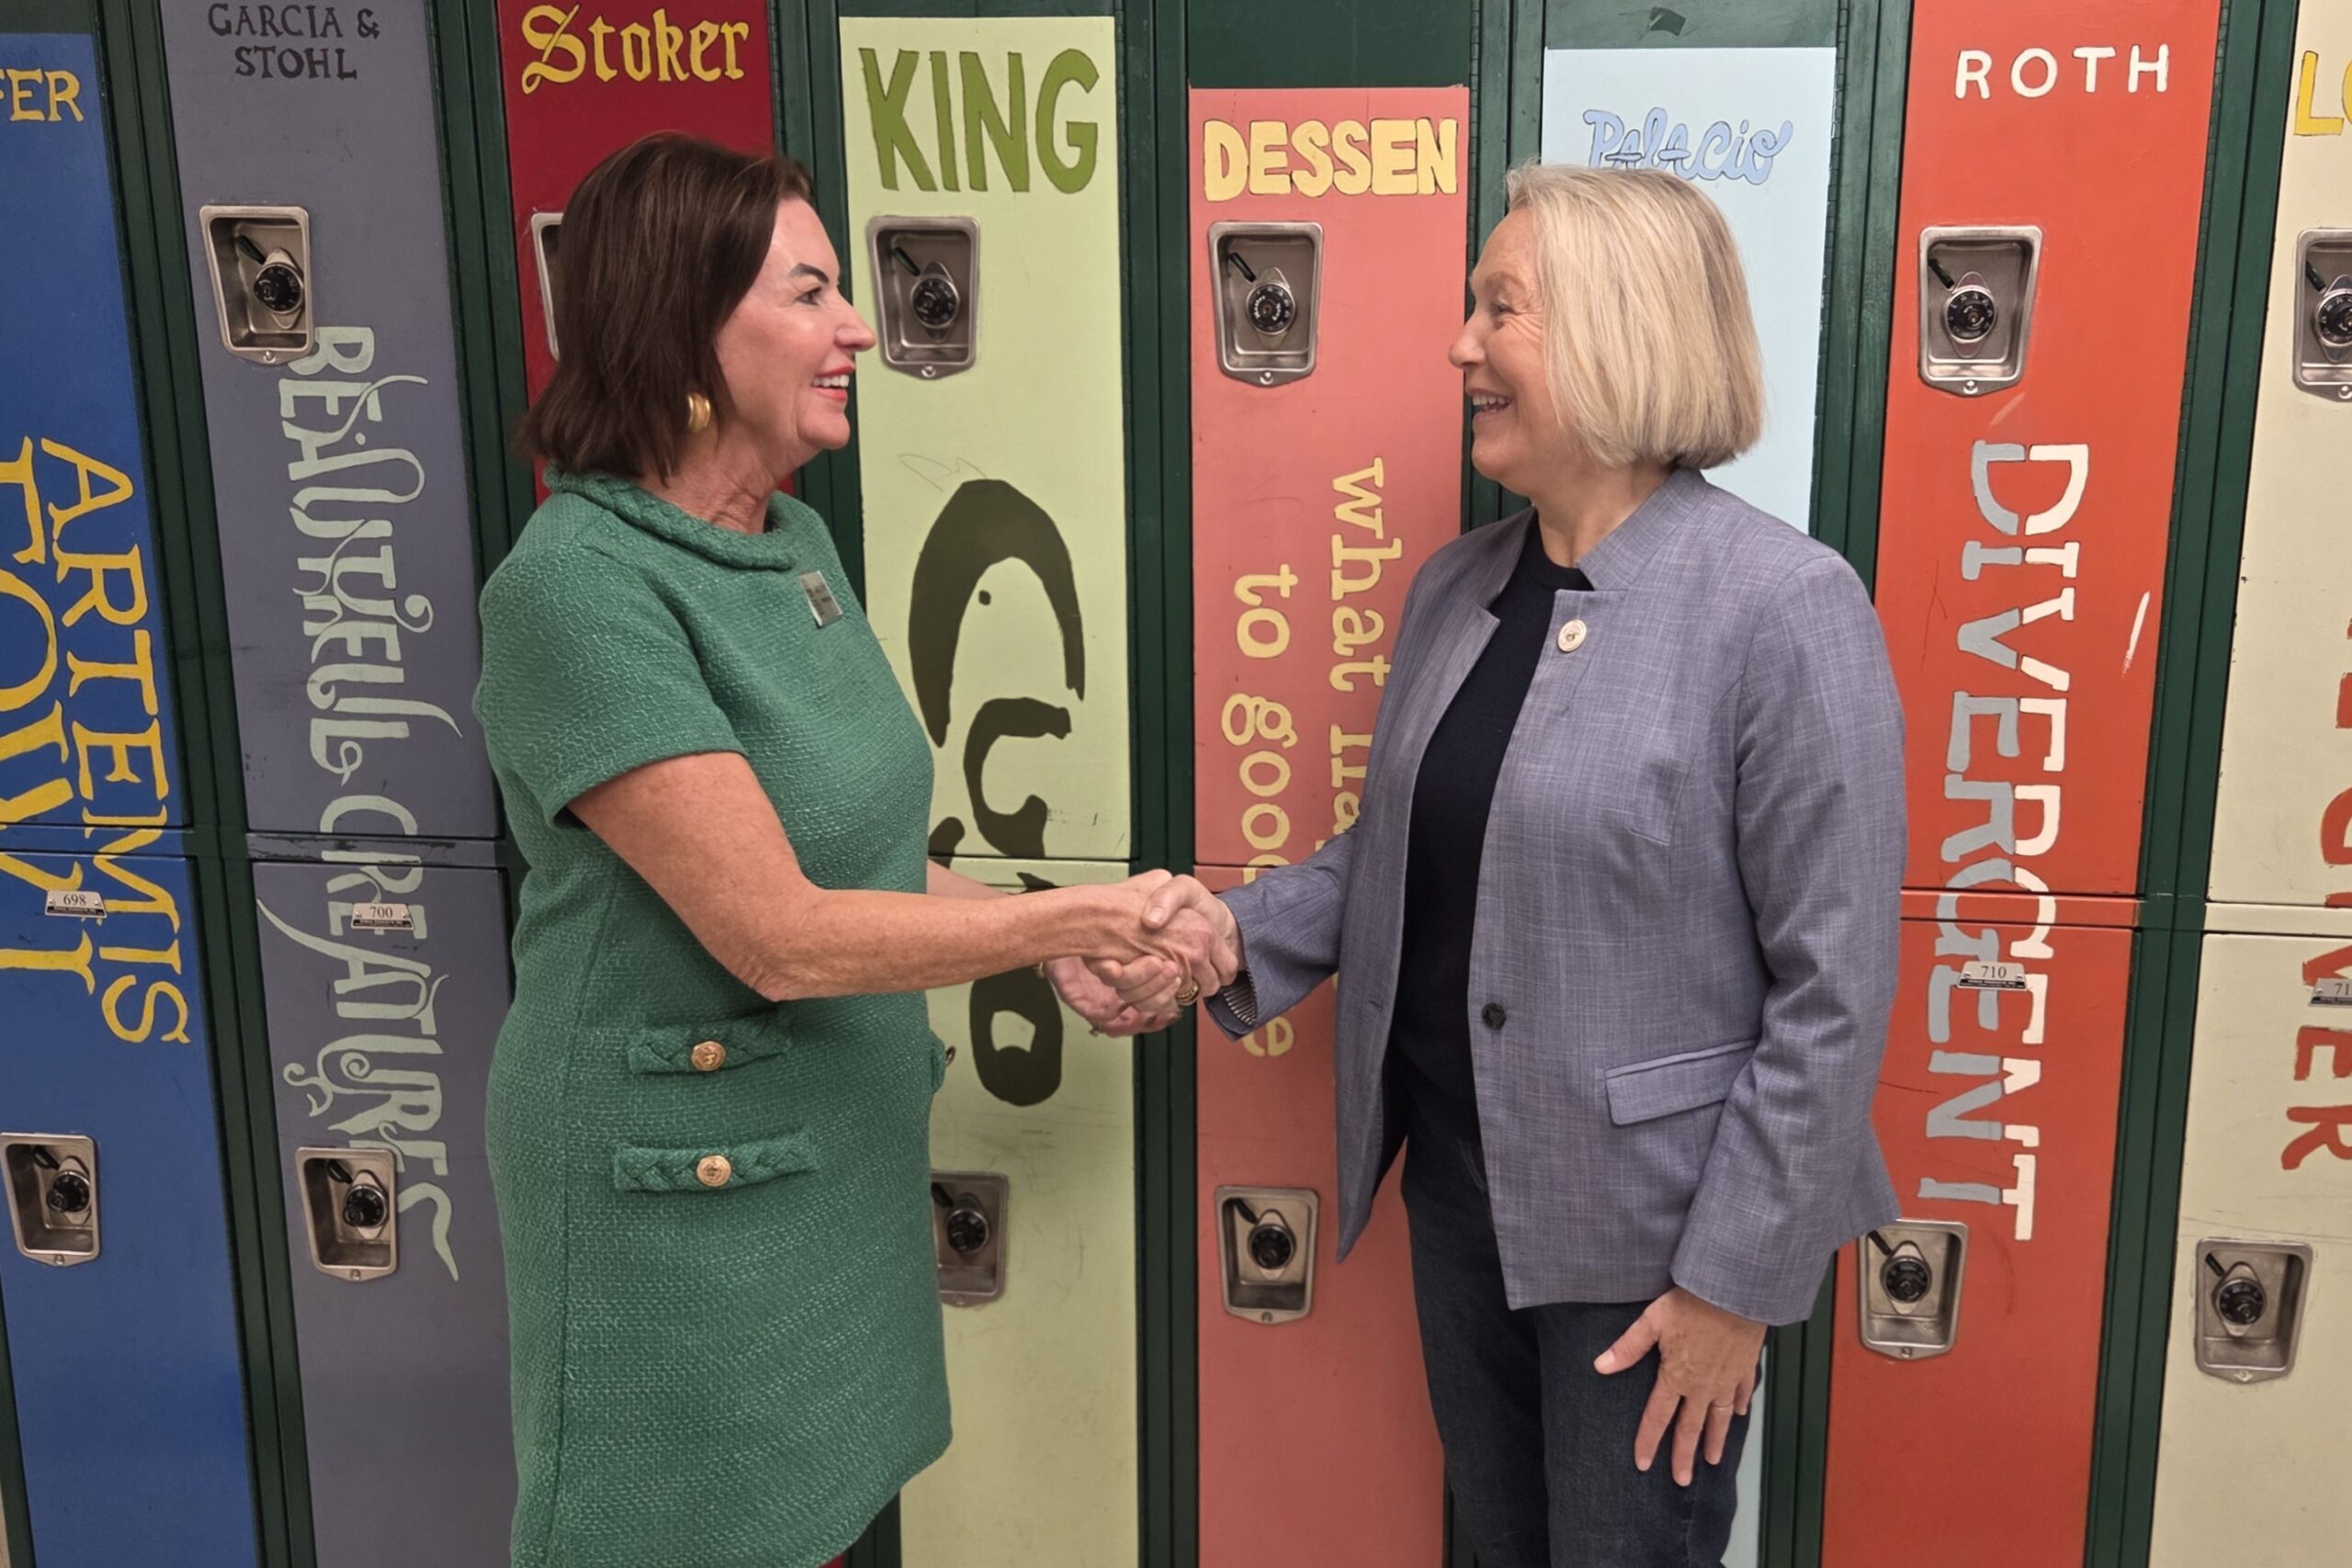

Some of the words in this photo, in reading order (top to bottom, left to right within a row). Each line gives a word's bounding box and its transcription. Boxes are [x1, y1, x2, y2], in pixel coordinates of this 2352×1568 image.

[208, 3, 344, 39] GARCIA
[356, 8, 380, 39] &
[234, 45, 357, 80] STOHL
[522, 4, 750, 95] Stoker
[1954, 44, 2169, 99] ROTH
[858, 48, 1100, 194] KING
[1203, 118, 1459, 202] DESSEN
[278, 326, 462, 786] BEAUTIFUL
[1329, 456, 1402, 693] what
[1234, 563, 1299, 659] to
[41, 435, 191, 1044] ARTEMIS
[1917, 439, 2089, 1242] DIVERGENT
[62, 894, 86, 907] 698
[369, 906, 393, 919] 700
[1981, 964, 2007, 978] 710
